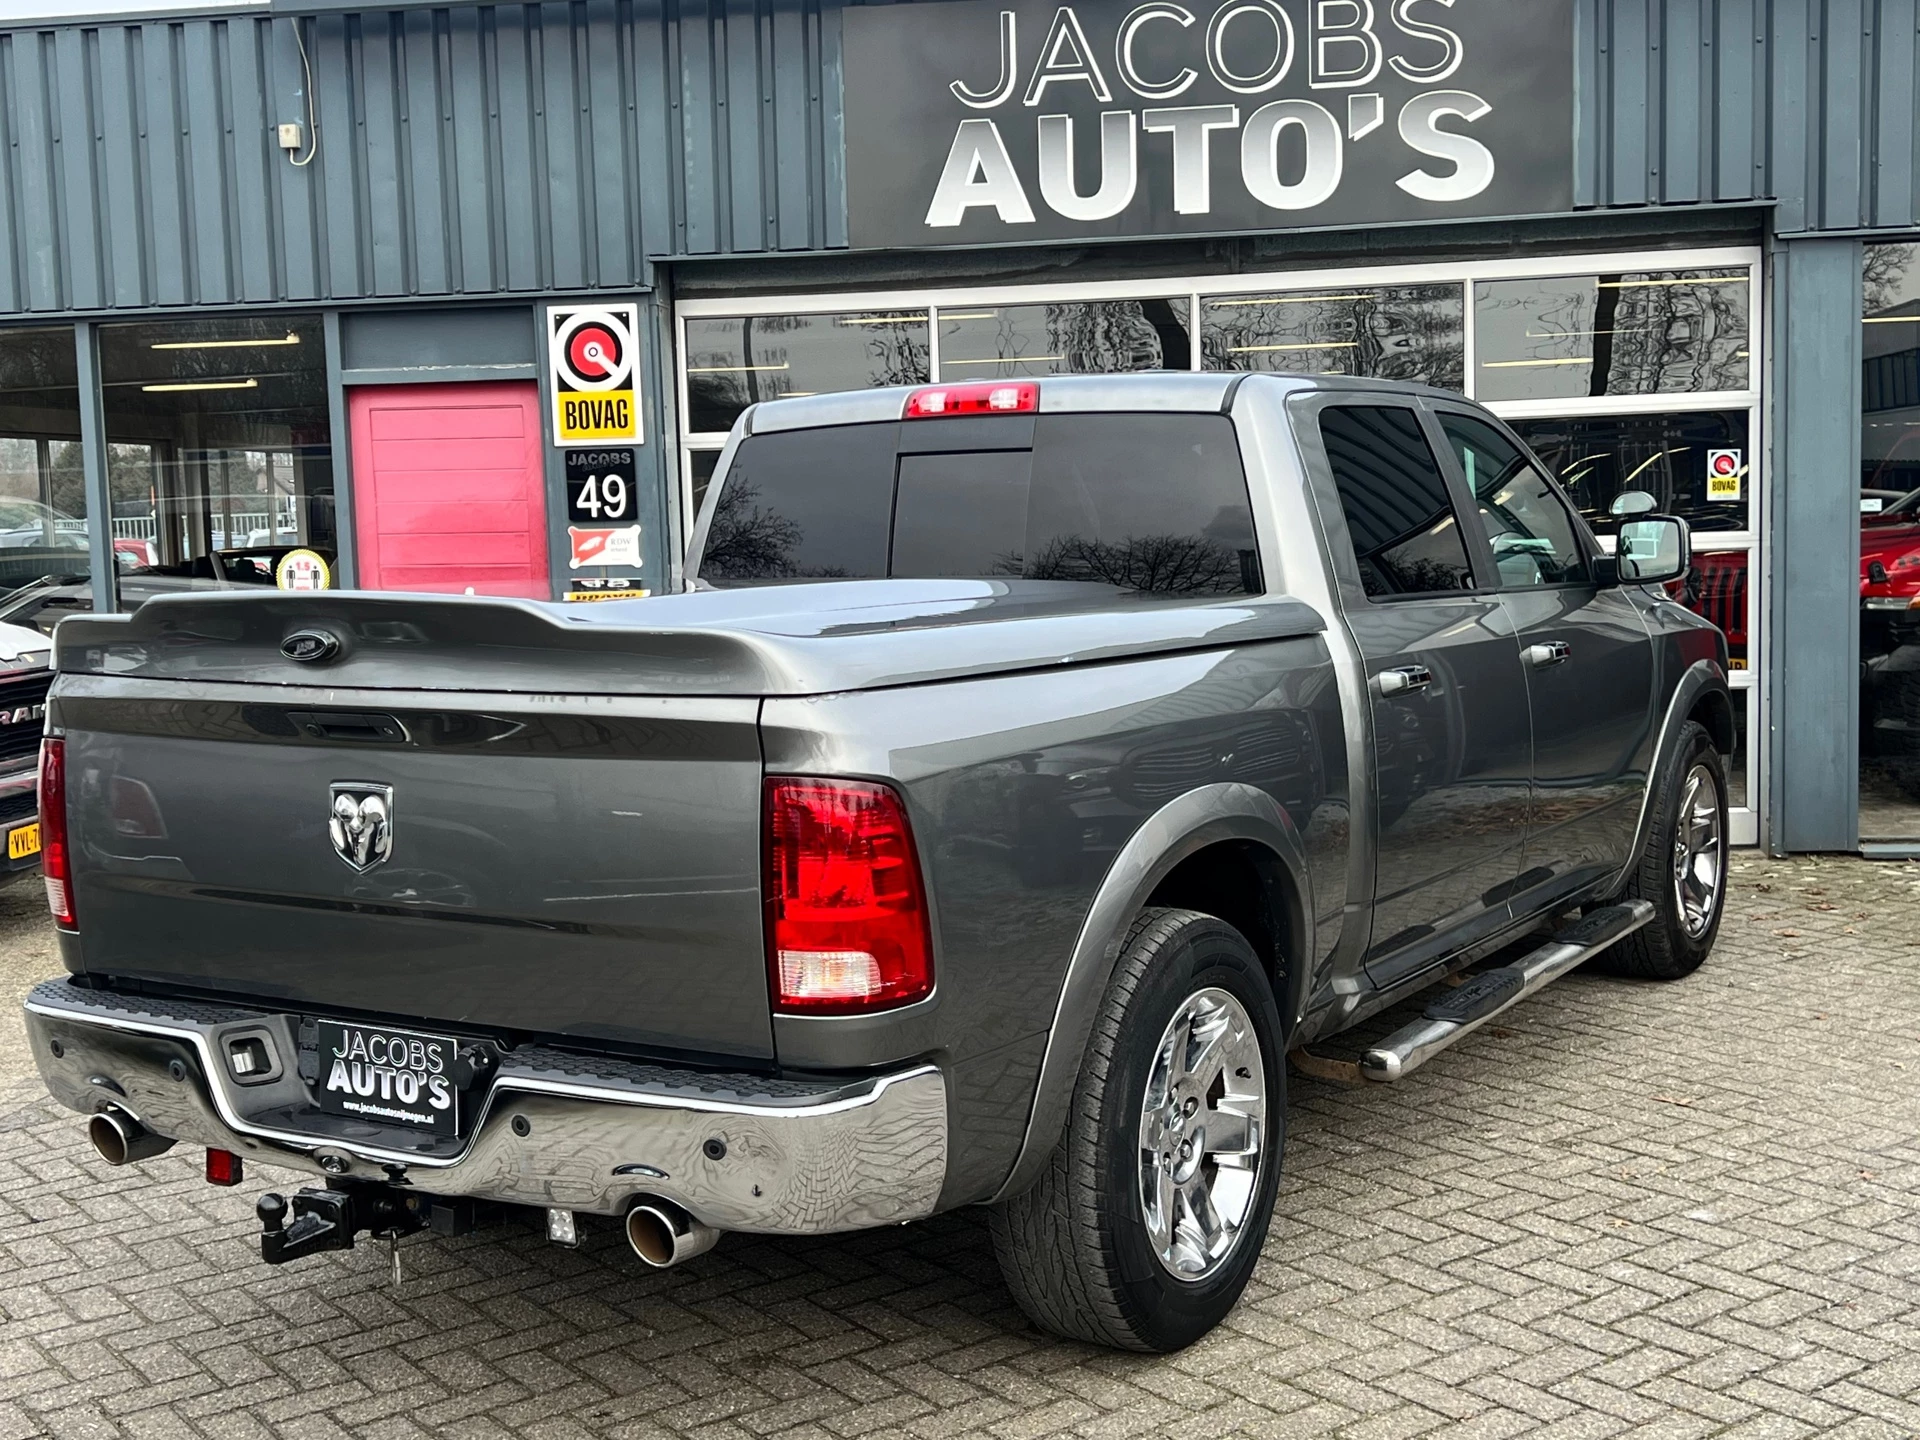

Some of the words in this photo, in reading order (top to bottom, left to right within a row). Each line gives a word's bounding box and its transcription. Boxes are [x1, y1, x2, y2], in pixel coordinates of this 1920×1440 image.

[949, 0, 1464, 109] JACOBS
[924, 89, 1495, 227] AUTO'S
[565, 399, 628, 430] BOVAG
[568, 452, 631, 466] JACOBS
[576, 474, 626, 518] 49
[1712, 480, 1736, 491] BOVAG
[610, 537, 632, 545] RDW
[332, 1029, 444, 1074] JACOBS
[326, 1059, 450, 1110] AUTO'S
